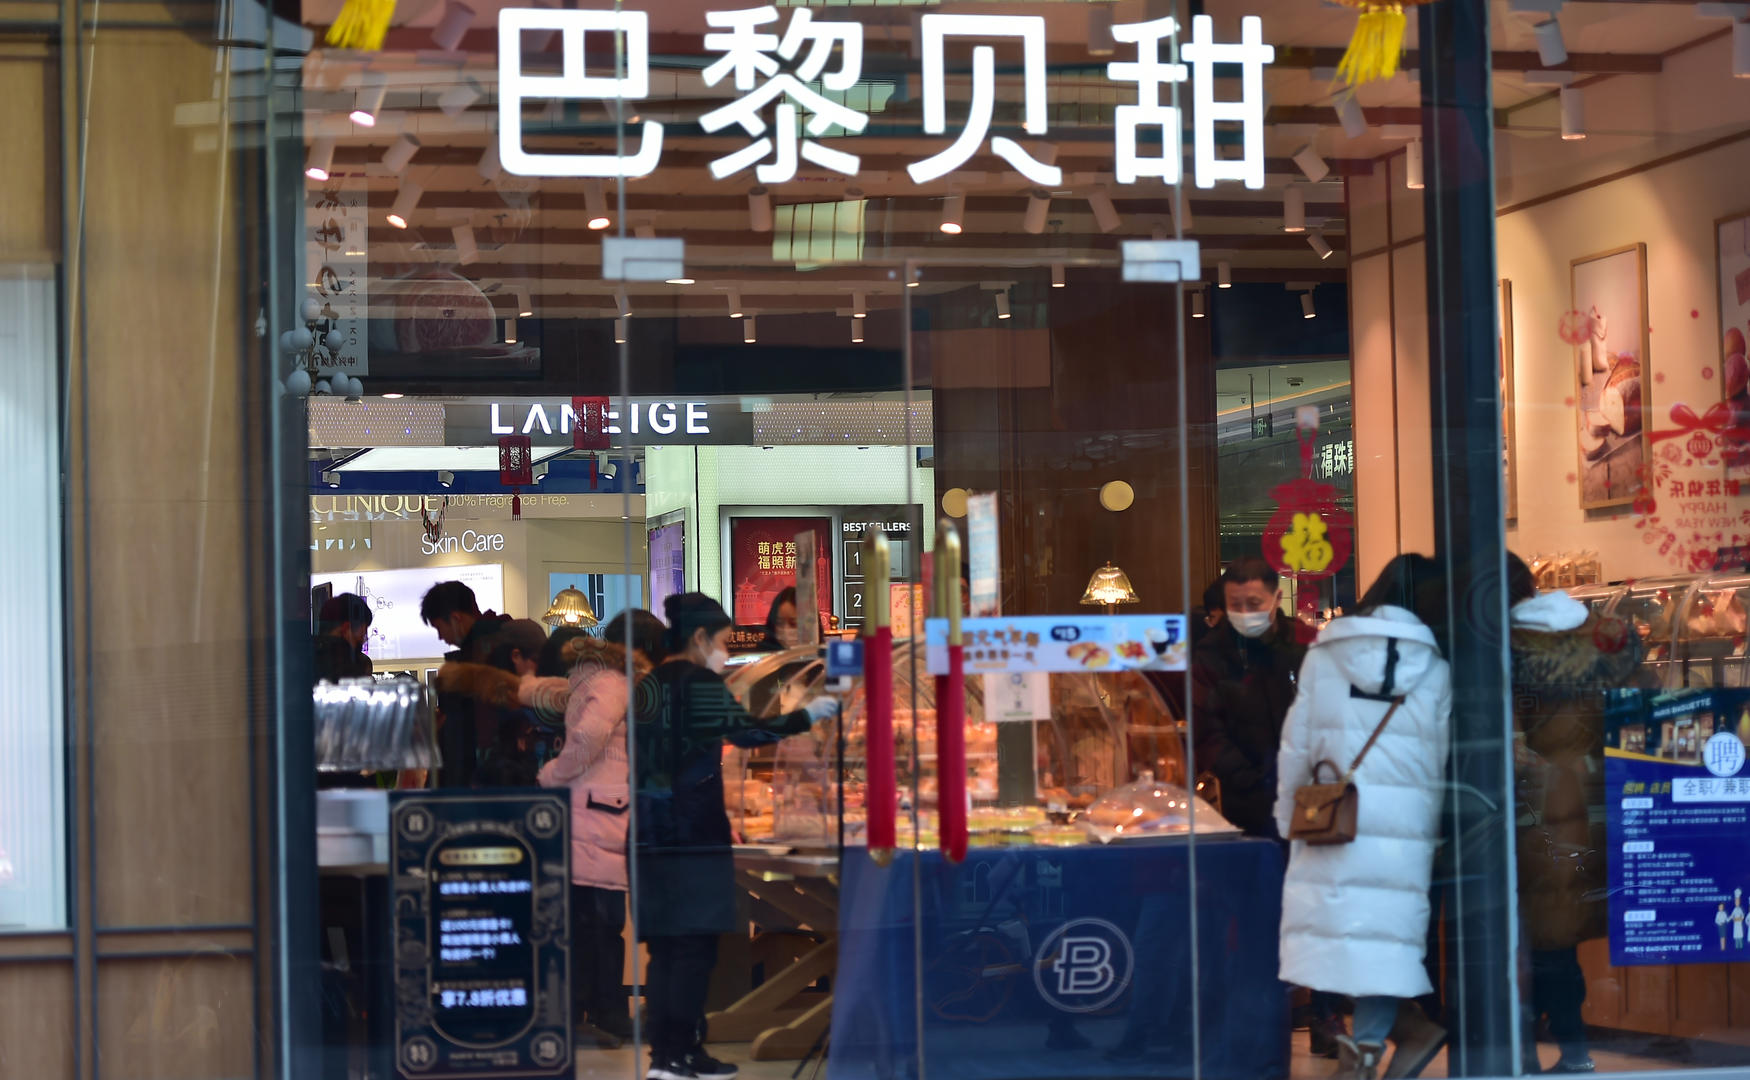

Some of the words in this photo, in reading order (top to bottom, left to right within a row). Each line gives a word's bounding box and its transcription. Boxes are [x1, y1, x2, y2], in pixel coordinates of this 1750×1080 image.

[498, 5, 1275, 189] 巴黎贝甜
[490, 402, 710, 434] LANEIGE
[312, 495, 438, 516] CLINIQUE
[843, 522, 867, 532] BEST
[421, 532, 458, 555] Skin
[461, 529, 504, 553] Care
[853, 551, 860, 566] 1
[853, 593, 862, 608] 2
[1710, 739, 1740, 773] 聘
